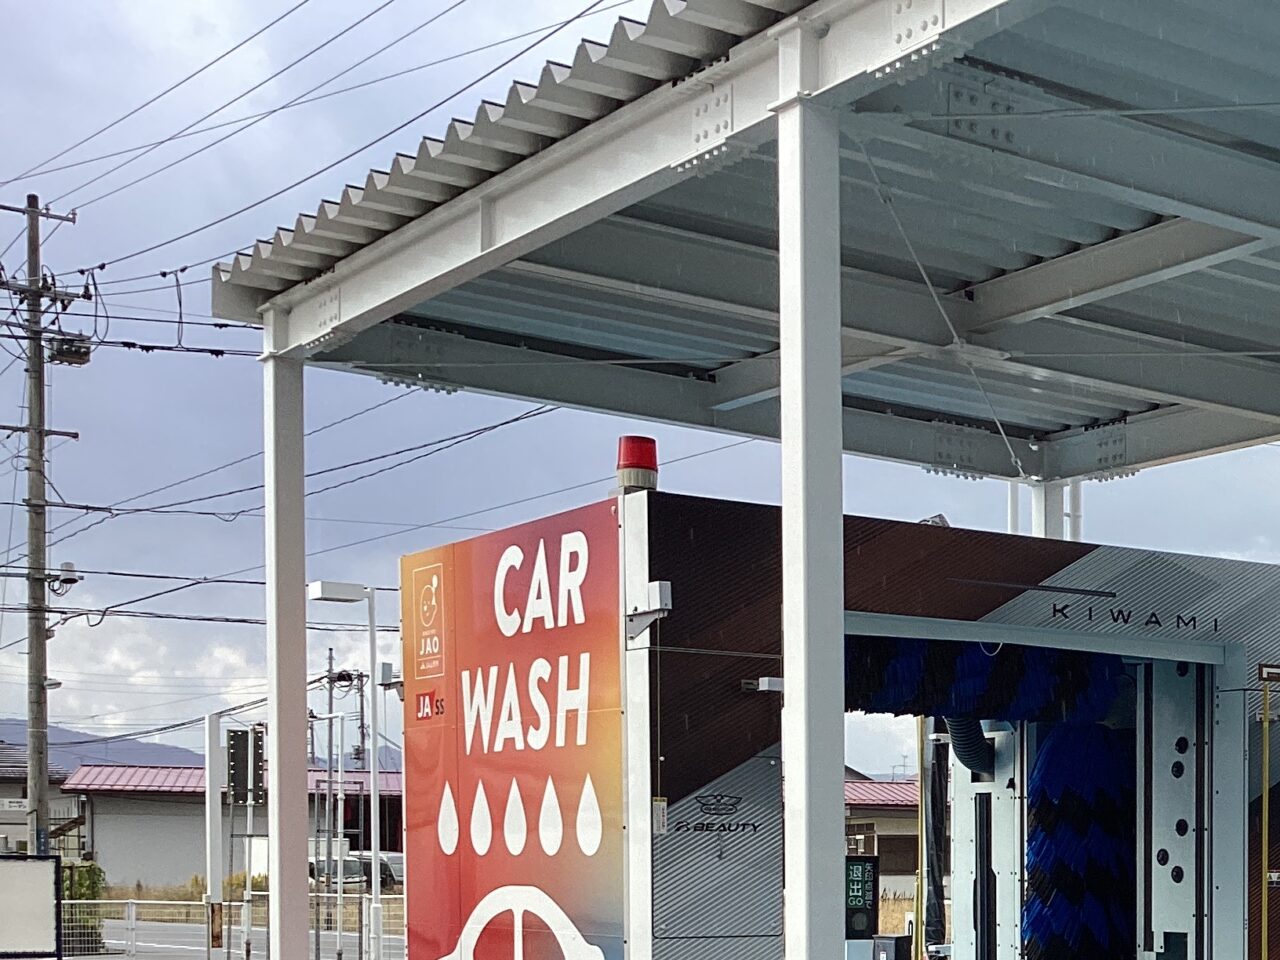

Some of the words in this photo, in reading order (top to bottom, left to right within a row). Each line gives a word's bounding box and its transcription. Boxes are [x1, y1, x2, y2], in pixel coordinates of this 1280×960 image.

[494, 530, 589, 638] CAR
[1052, 603, 1219, 633] KIWAMI
[420, 635, 439, 656] JAO
[417, 695, 432, 718] JA
[435, 698, 445, 716] SS
[461, 652, 591, 756] WASH
[848, 865, 863, 897] 退出
[848, 897, 864, 906] GO
